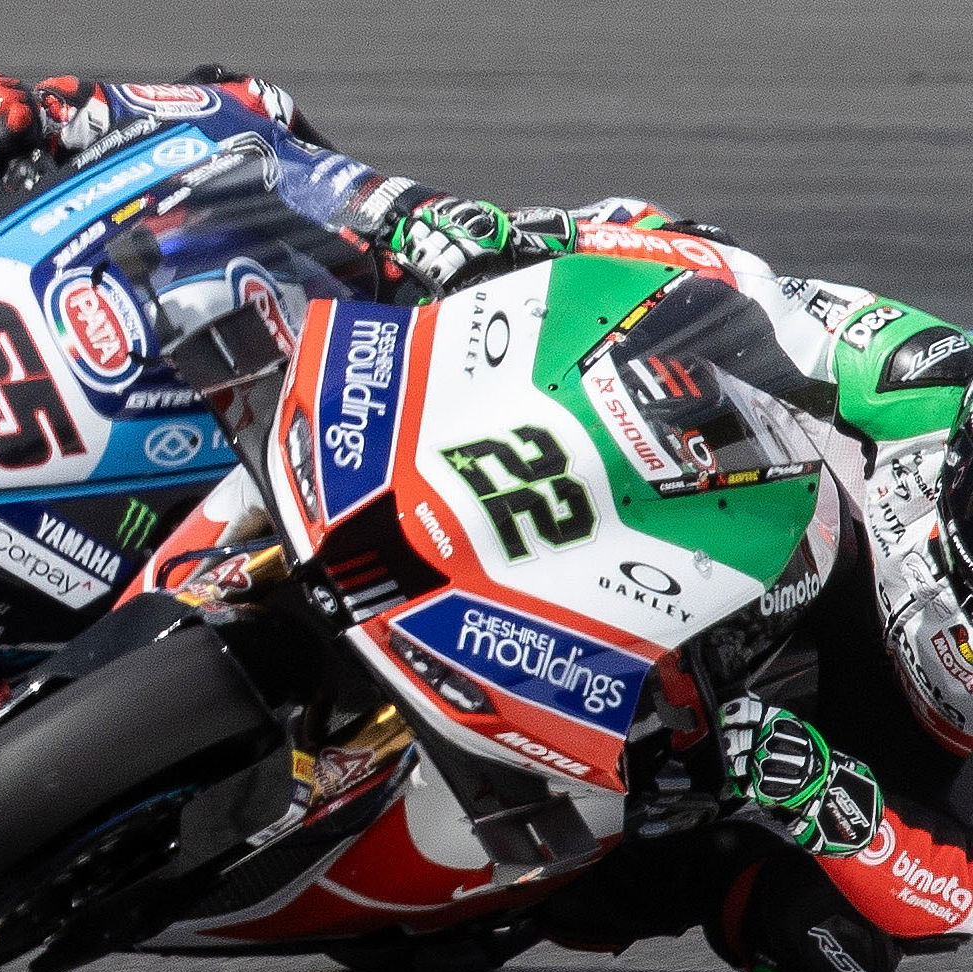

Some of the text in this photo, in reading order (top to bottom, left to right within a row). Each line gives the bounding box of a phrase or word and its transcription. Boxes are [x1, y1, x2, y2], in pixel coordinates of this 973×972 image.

[69, 290, 121, 365] PATA
[463, 291, 487, 380] OAKLEY
[901, 333, 971, 382] RST
[325, 319, 387, 471] mouldings
[607, 399, 666, 472] SHOWA
[437, 424, 599, 564] 22
[36, 511, 123, 582] YAMAHA
[414, 502, 454, 559] bimota
[599, 575, 694, 624] OAKLEY
[759, 571, 822, 617] bimota
[464, 608, 550, 649] CHESHIRE
[457, 624, 626, 713] mouldings
[495, 731, 592, 776] MOTUL
[828, 786, 871, 828] RST
[892, 850, 973, 911] bimota
